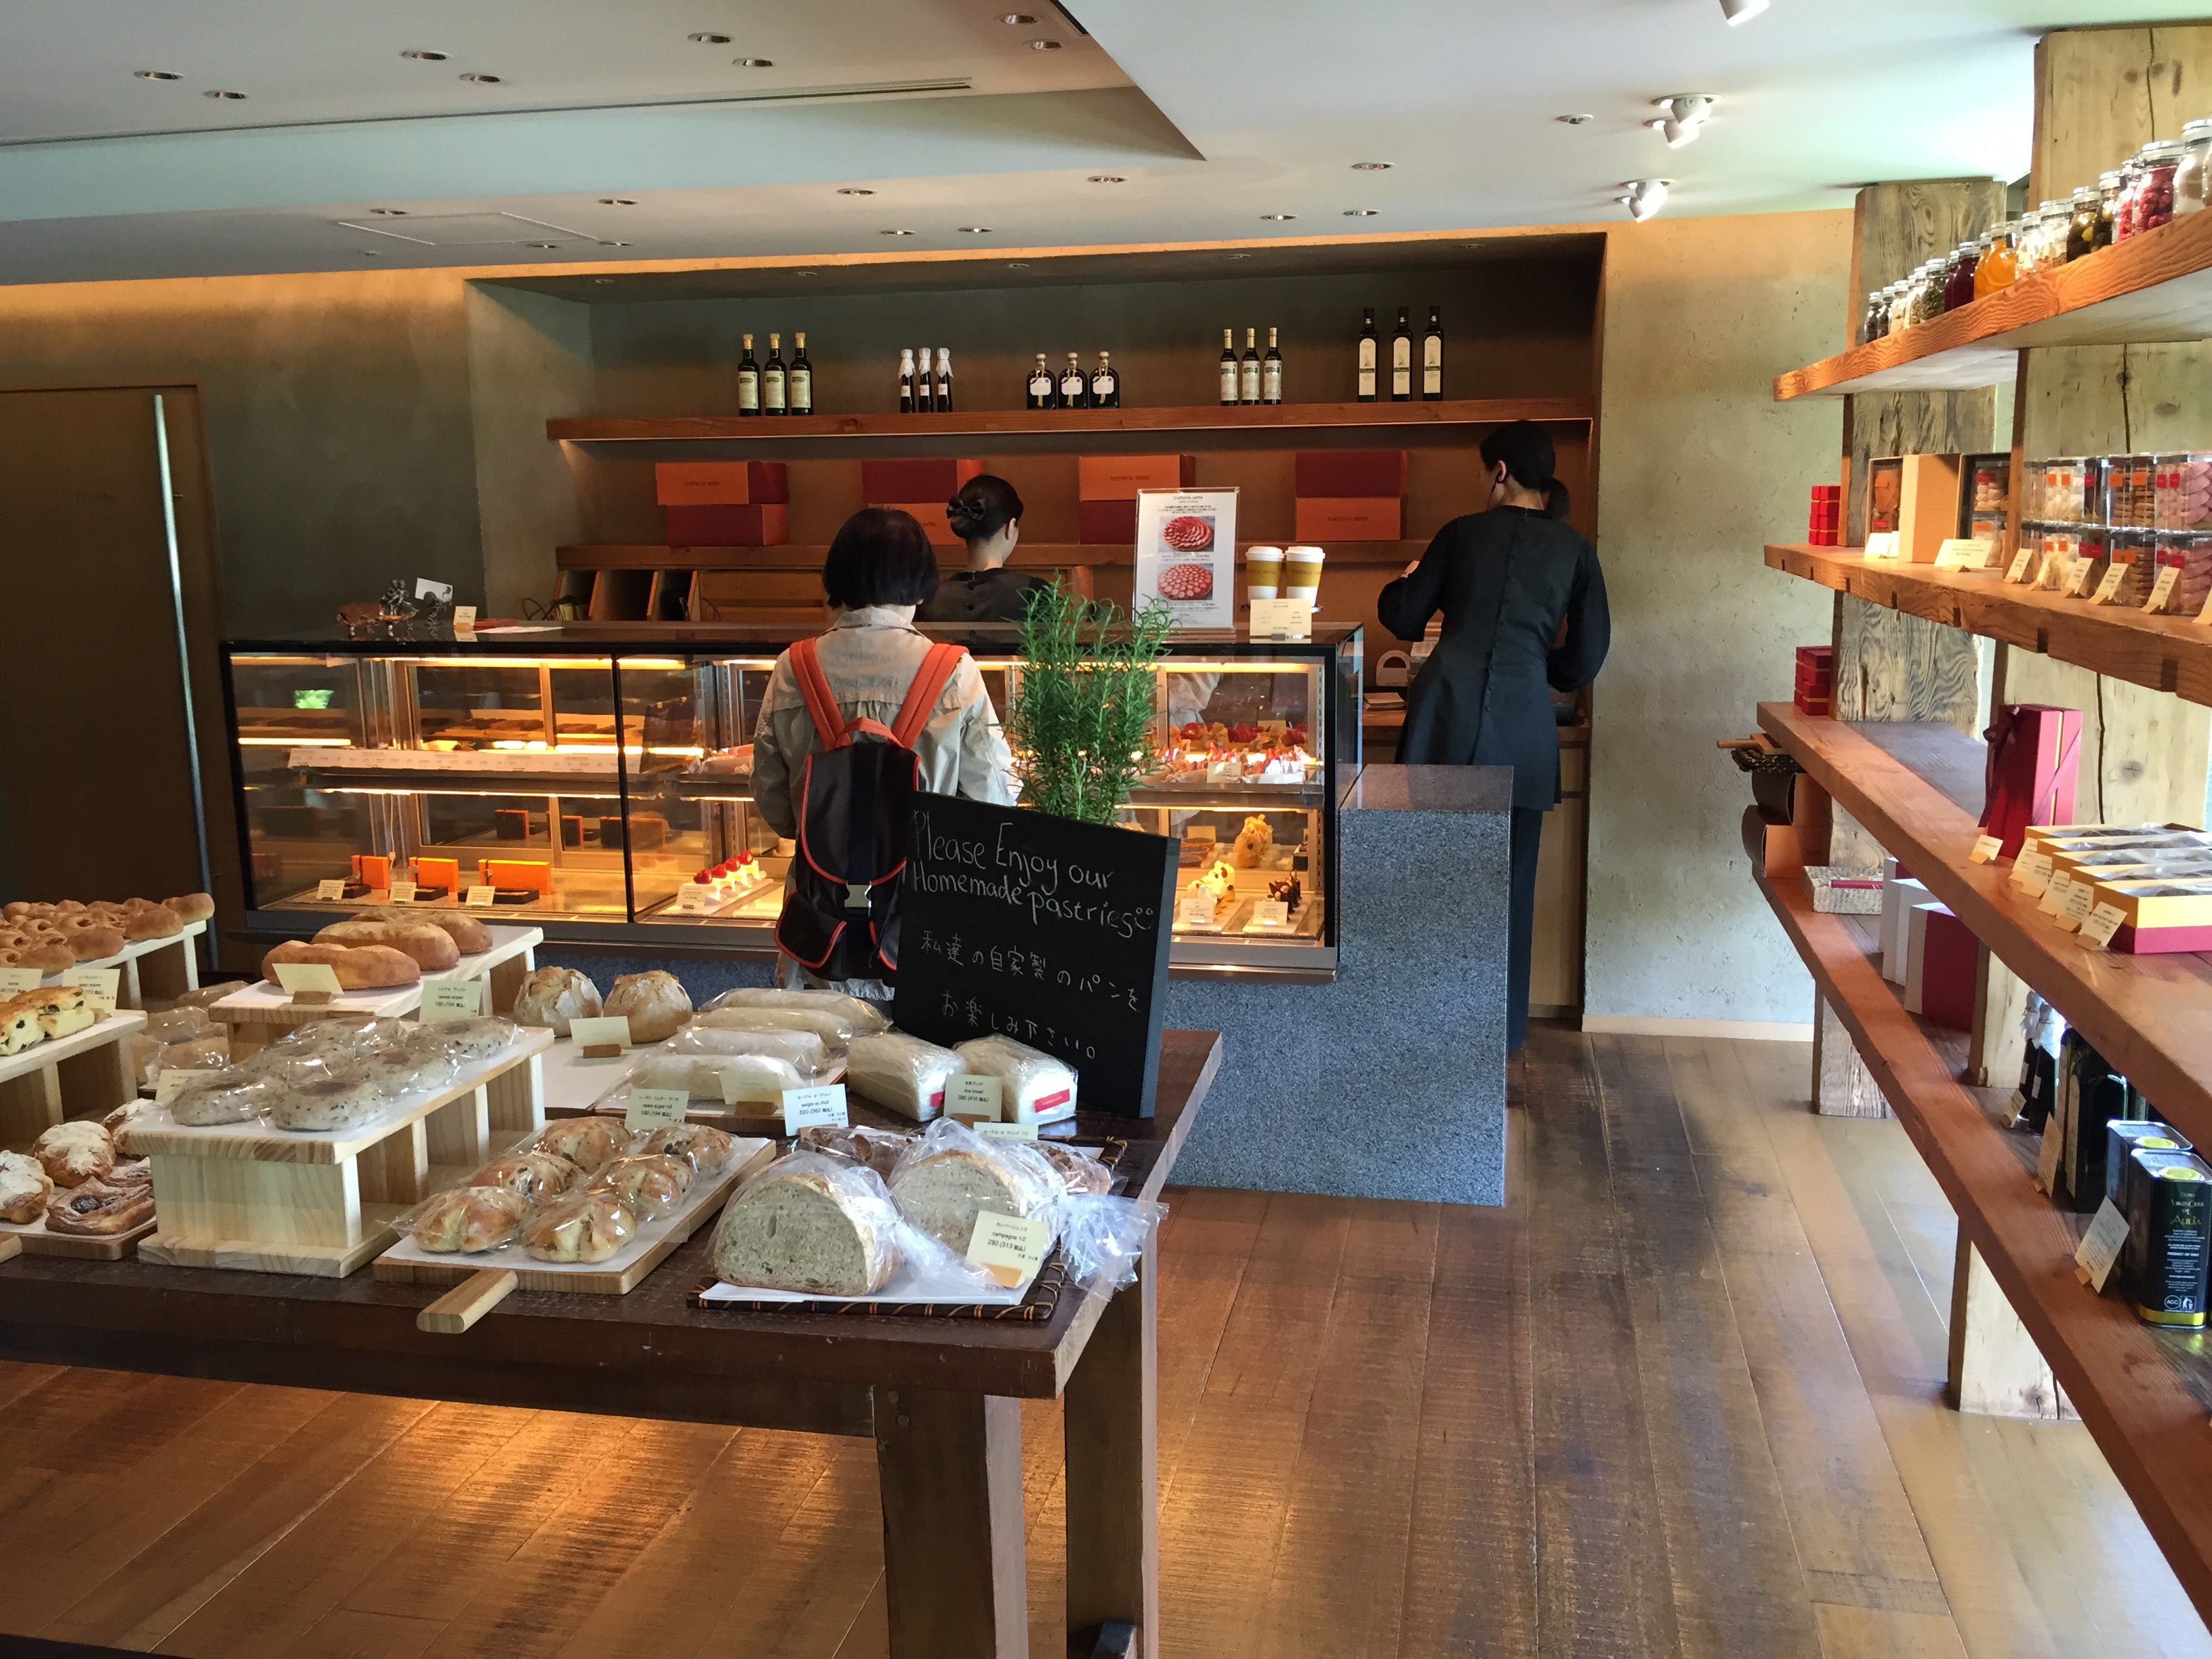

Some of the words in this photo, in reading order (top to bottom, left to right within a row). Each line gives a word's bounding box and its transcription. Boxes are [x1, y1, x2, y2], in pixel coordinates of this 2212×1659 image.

[912, 810, 986, 869] Please
[996, 822, 1057, 896] Enjoy
[1069, 864, 1114, 890] our
[913, 859, 1023, 905] Homemade
[1027, 891, 1132, 939] pastries
[922, 930, 1141, 1012] 私達の自家製のパンを
[992, 1231, 1017, 1240] campagne
[1000, 1241, 1012, 1249] (313
